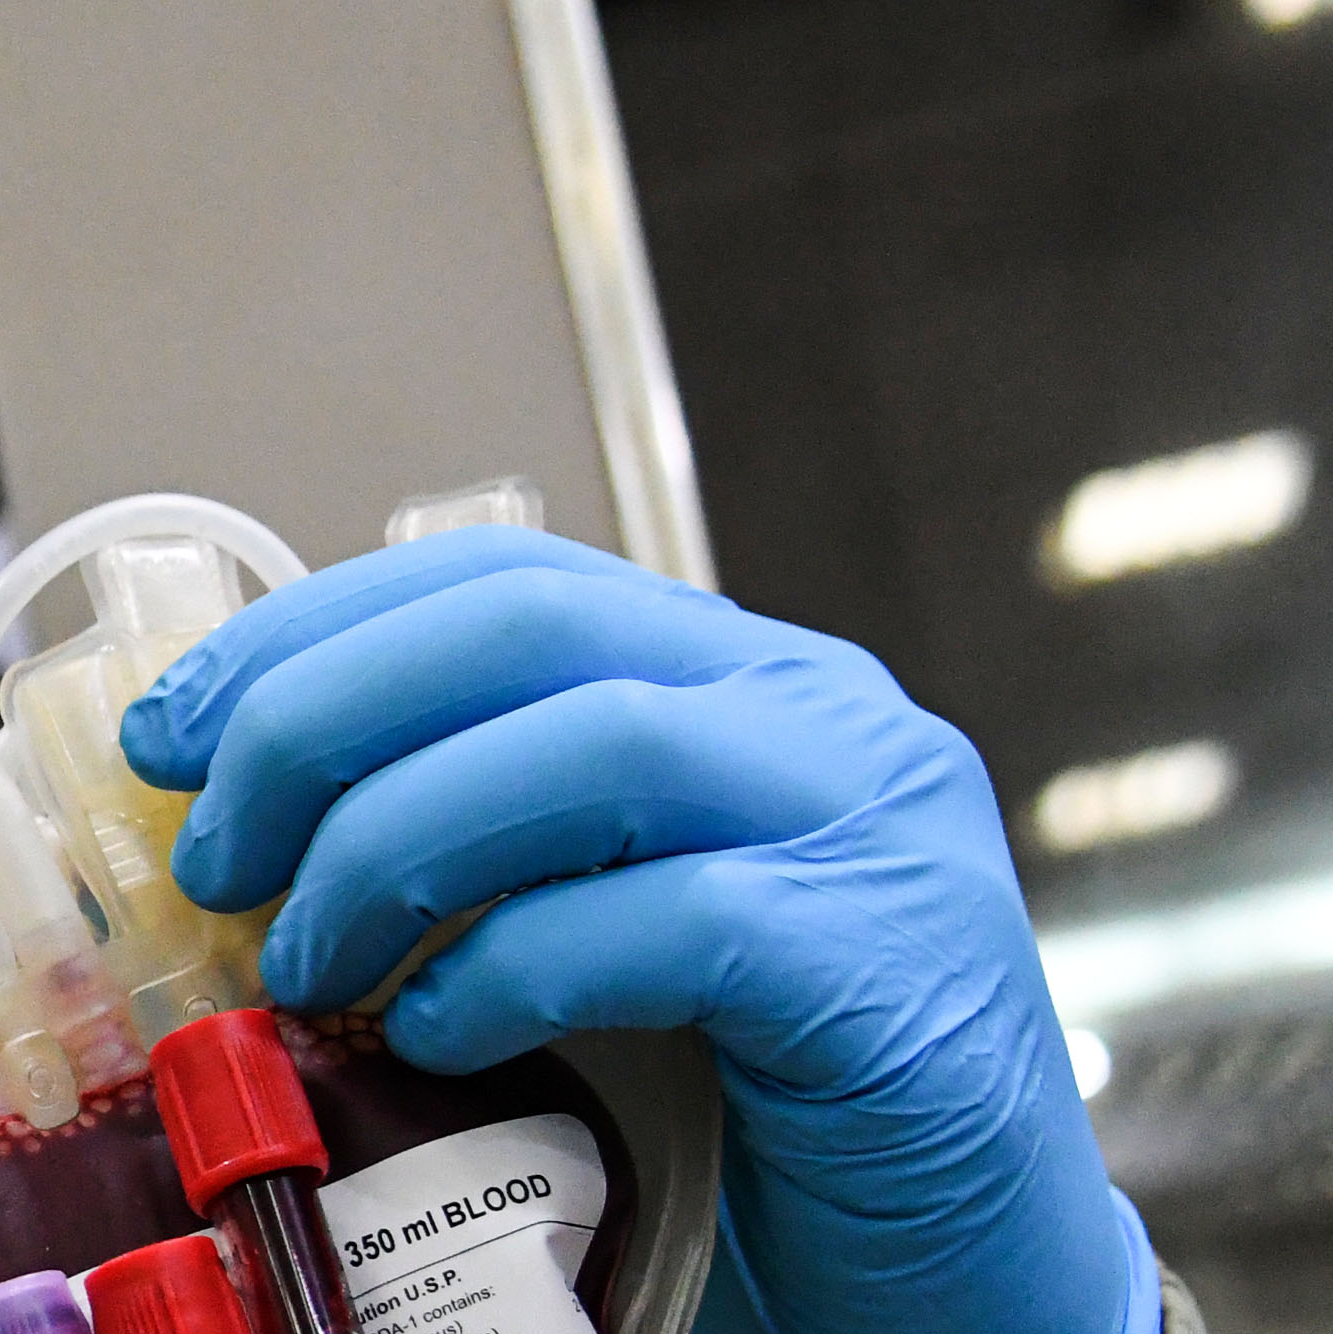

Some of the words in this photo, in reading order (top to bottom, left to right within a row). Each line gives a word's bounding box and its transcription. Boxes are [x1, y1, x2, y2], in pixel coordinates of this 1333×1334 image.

[344, 1228, 396, 1268] 350
[402, 1210, 439, 1245] ml
[442, 1174, 551, 1228] BLOOD
[404, 1269, 462, 1302] U.S.P.
[423, 1285, 496, 1323] contains:
